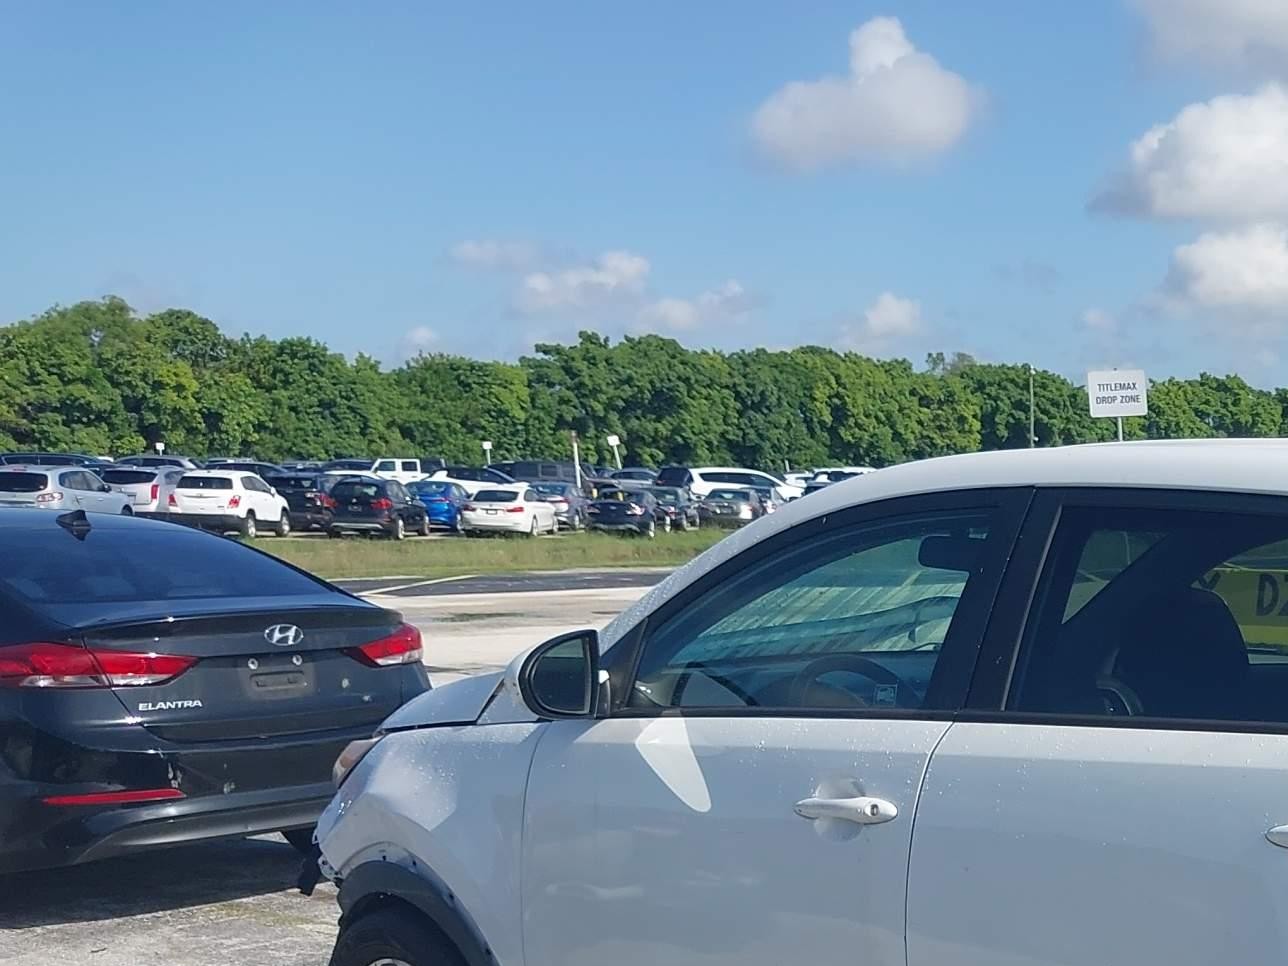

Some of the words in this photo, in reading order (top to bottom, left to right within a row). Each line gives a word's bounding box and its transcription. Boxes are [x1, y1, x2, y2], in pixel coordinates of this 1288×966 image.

[1097, 383, 1137, 392] TITLEMAX
[1095, 395, 1118, 405] DROP
[1119, 394, 1141, 404] ZONE
[138, 700, 203, 711] ELANTRA
